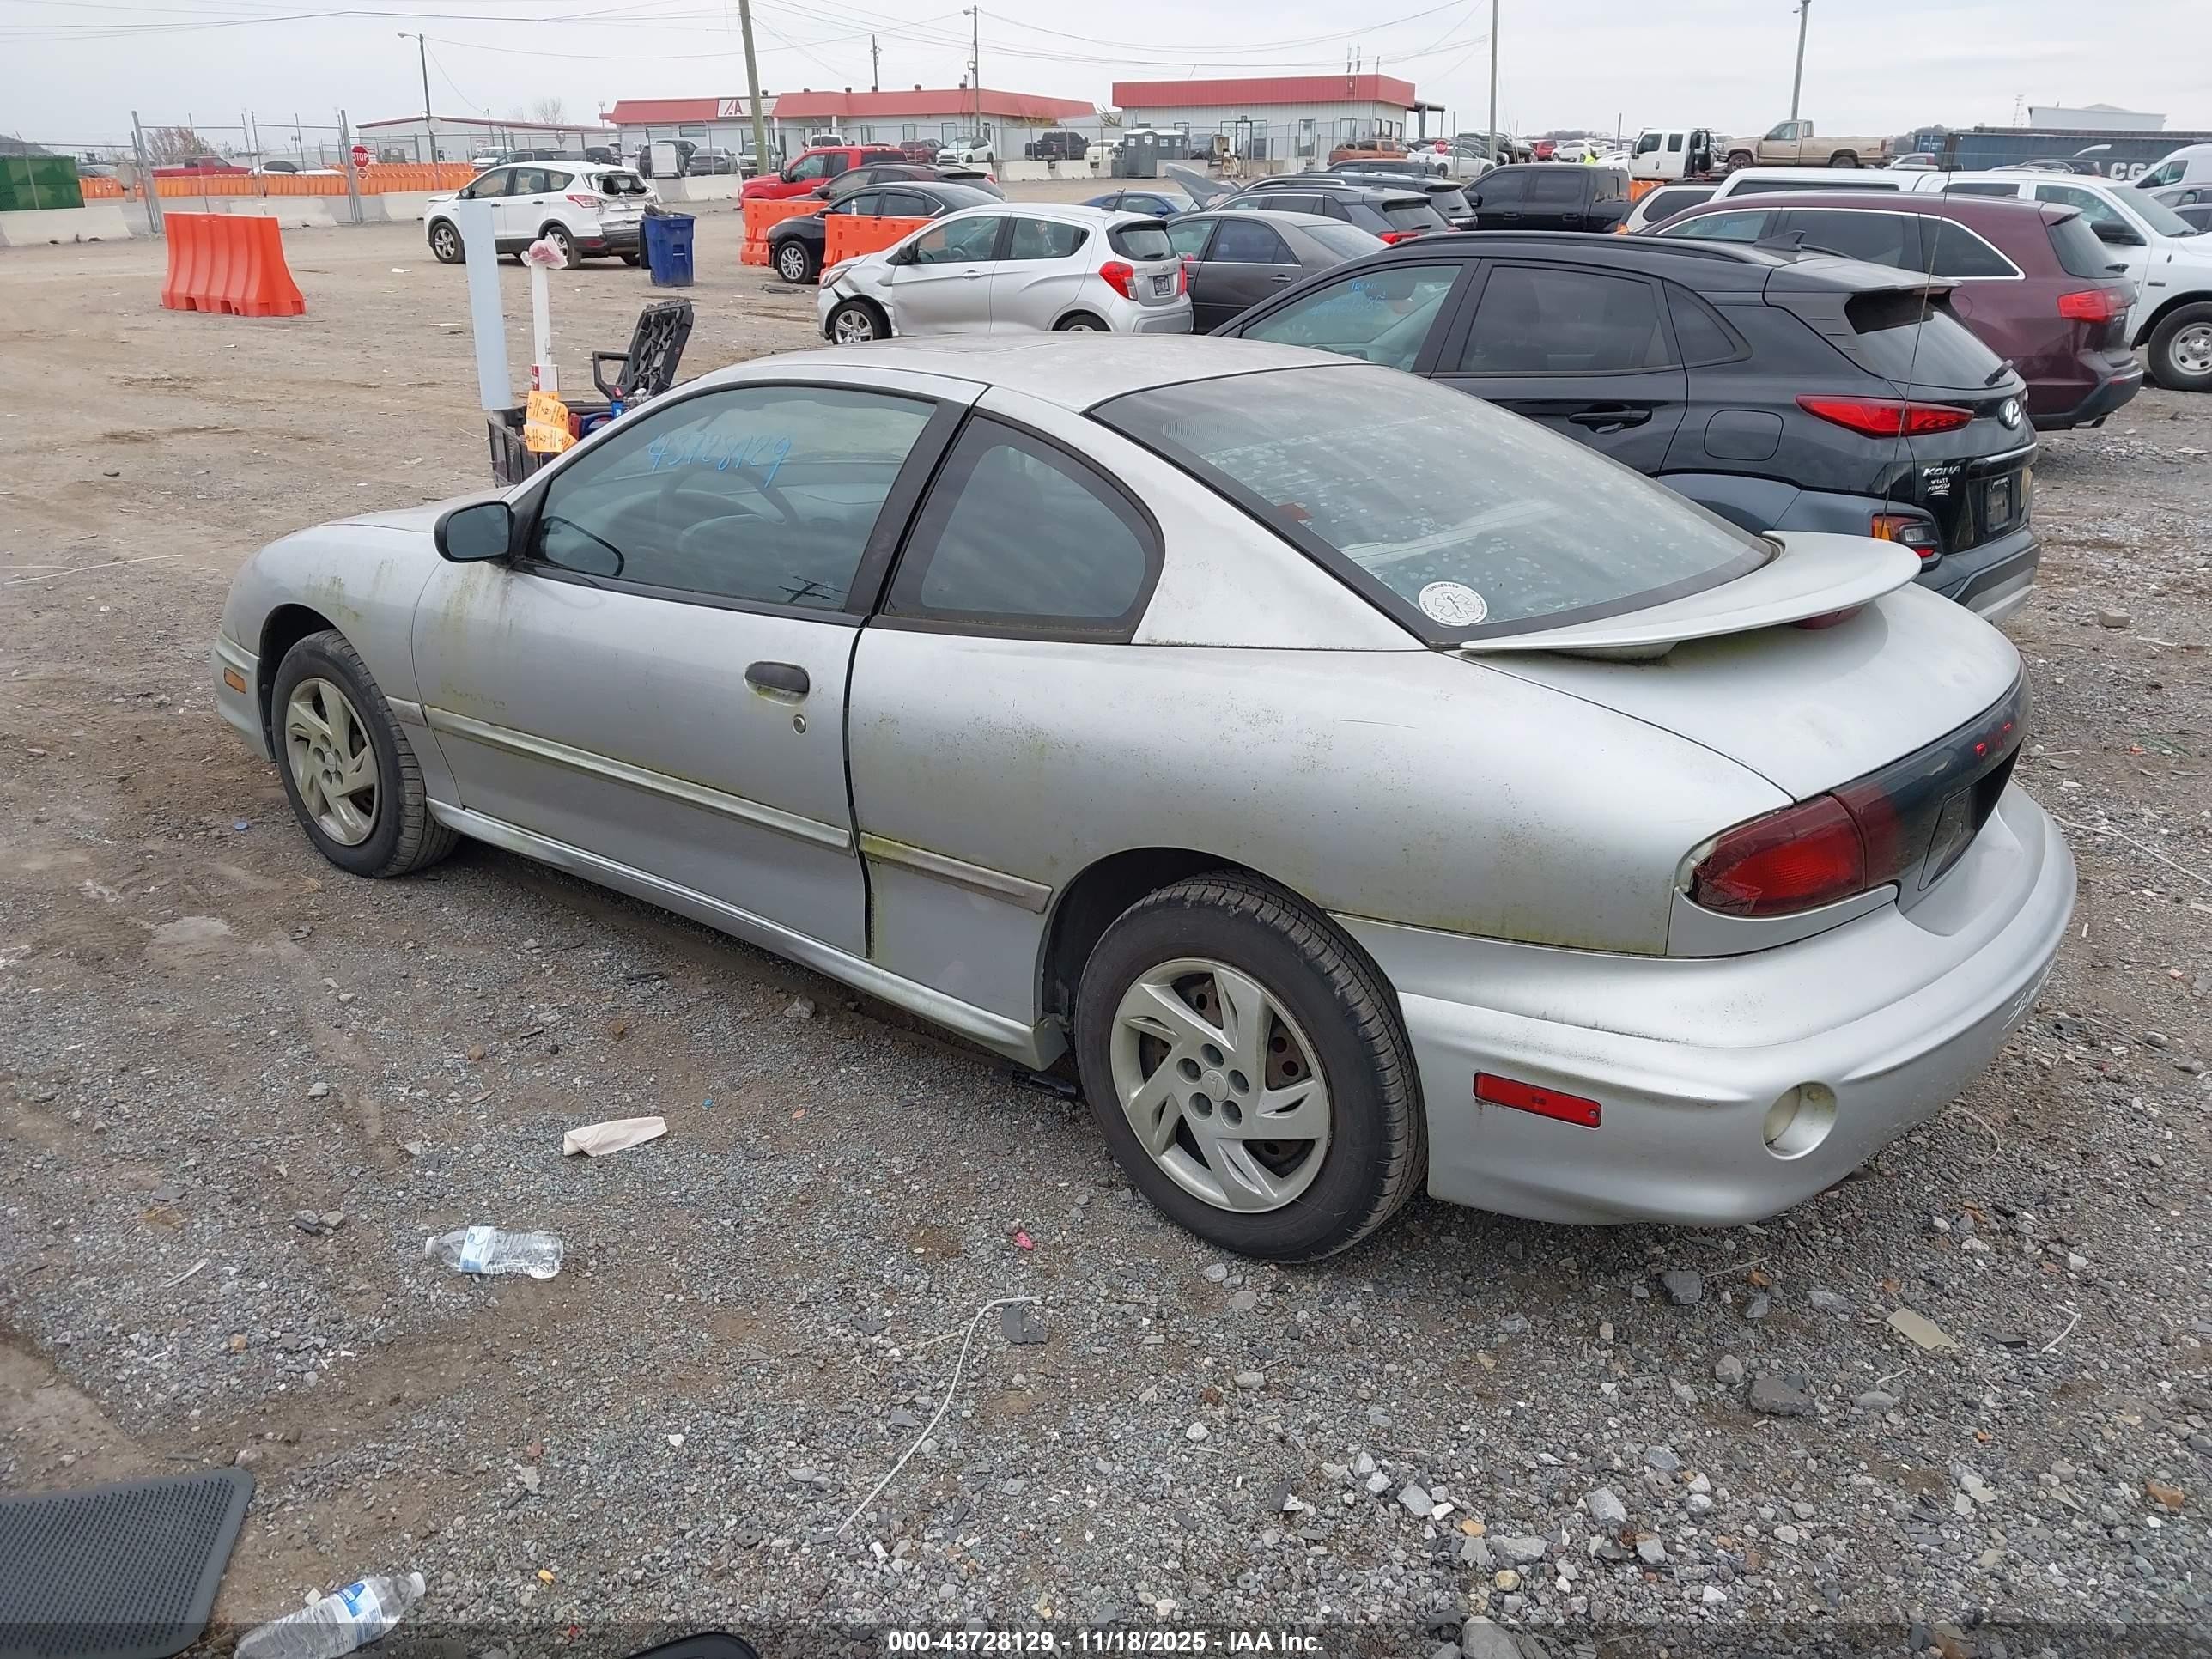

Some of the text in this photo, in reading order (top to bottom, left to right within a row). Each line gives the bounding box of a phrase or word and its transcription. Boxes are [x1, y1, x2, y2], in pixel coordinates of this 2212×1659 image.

[352, 152, 368, 161] STOP
[647, 433, 792, 489] 43728129
[1923, 465, 1960, 477] KONA
